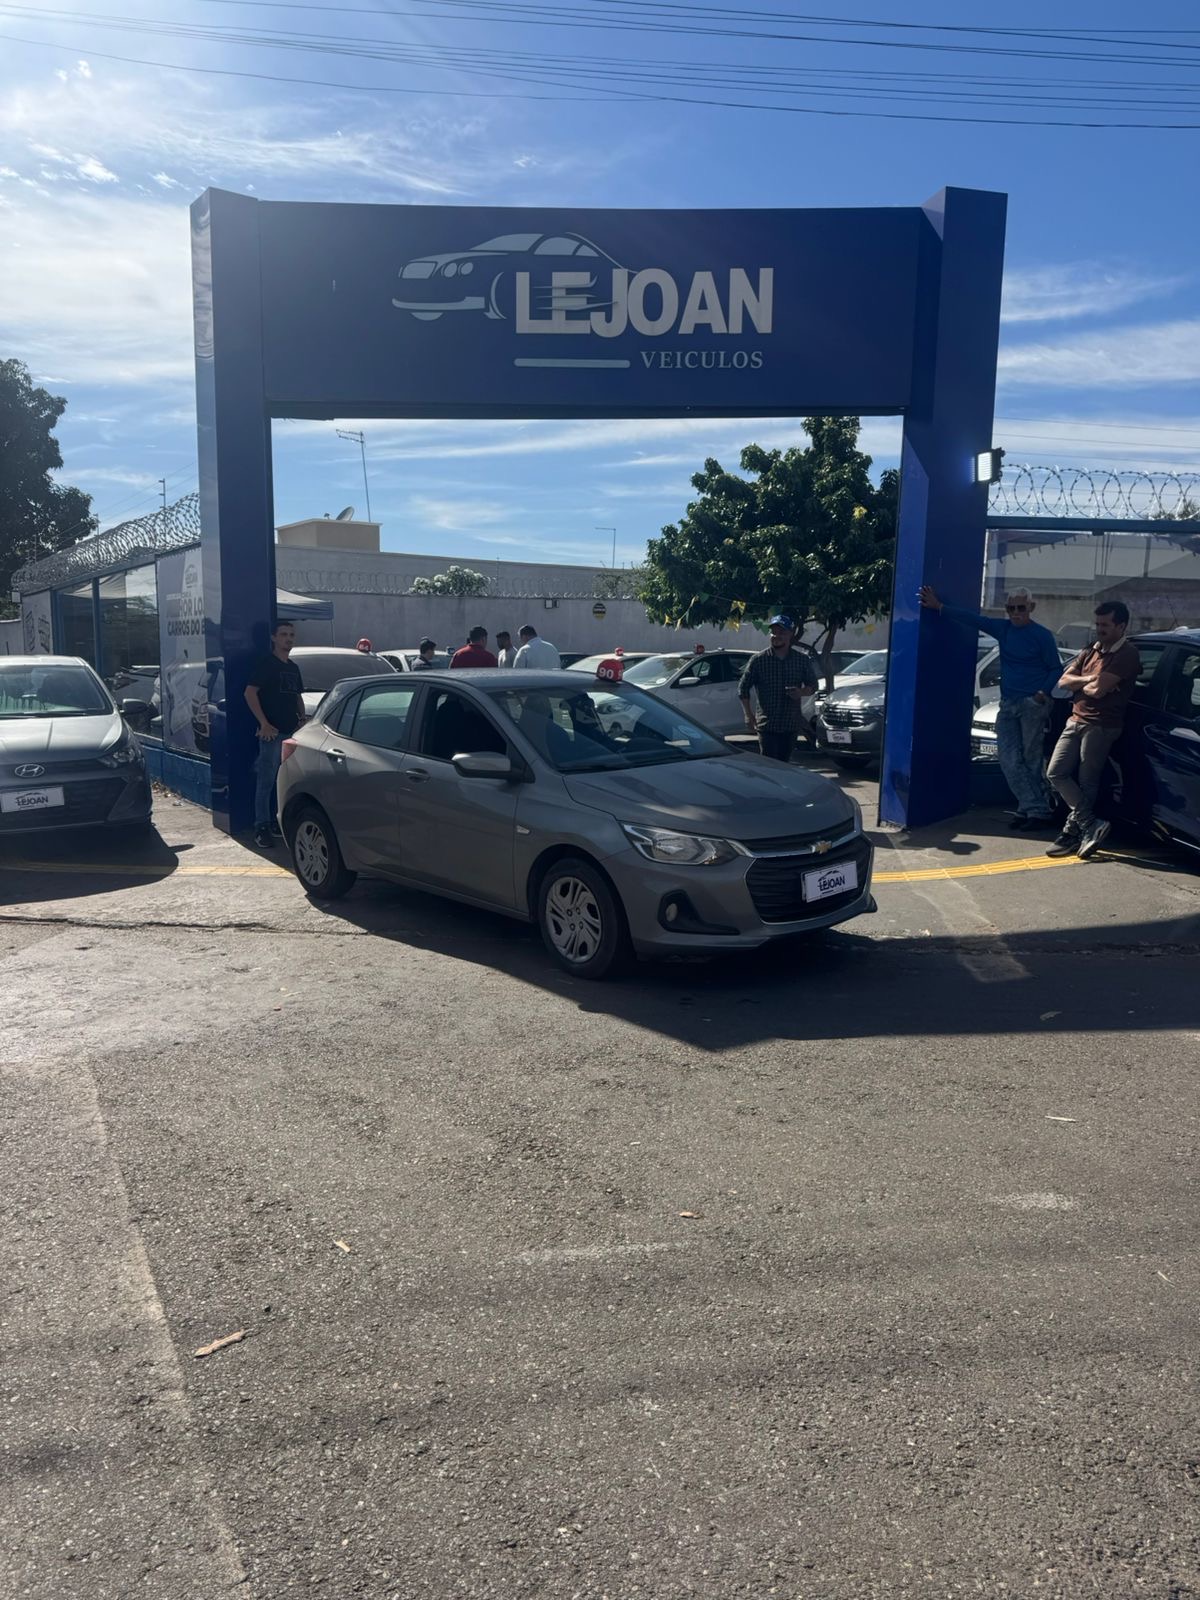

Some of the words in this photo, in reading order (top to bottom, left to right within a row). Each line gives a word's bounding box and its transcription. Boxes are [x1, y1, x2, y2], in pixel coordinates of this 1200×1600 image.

[515, 267, 775, 338] LEJOAN
[640, 351, 764, 369] VEICULOS
[599, 667, 614, 679] 90
[16, 796, 49, 806] LEJOAN
[818, 875, 845, 891] LEJOAN
